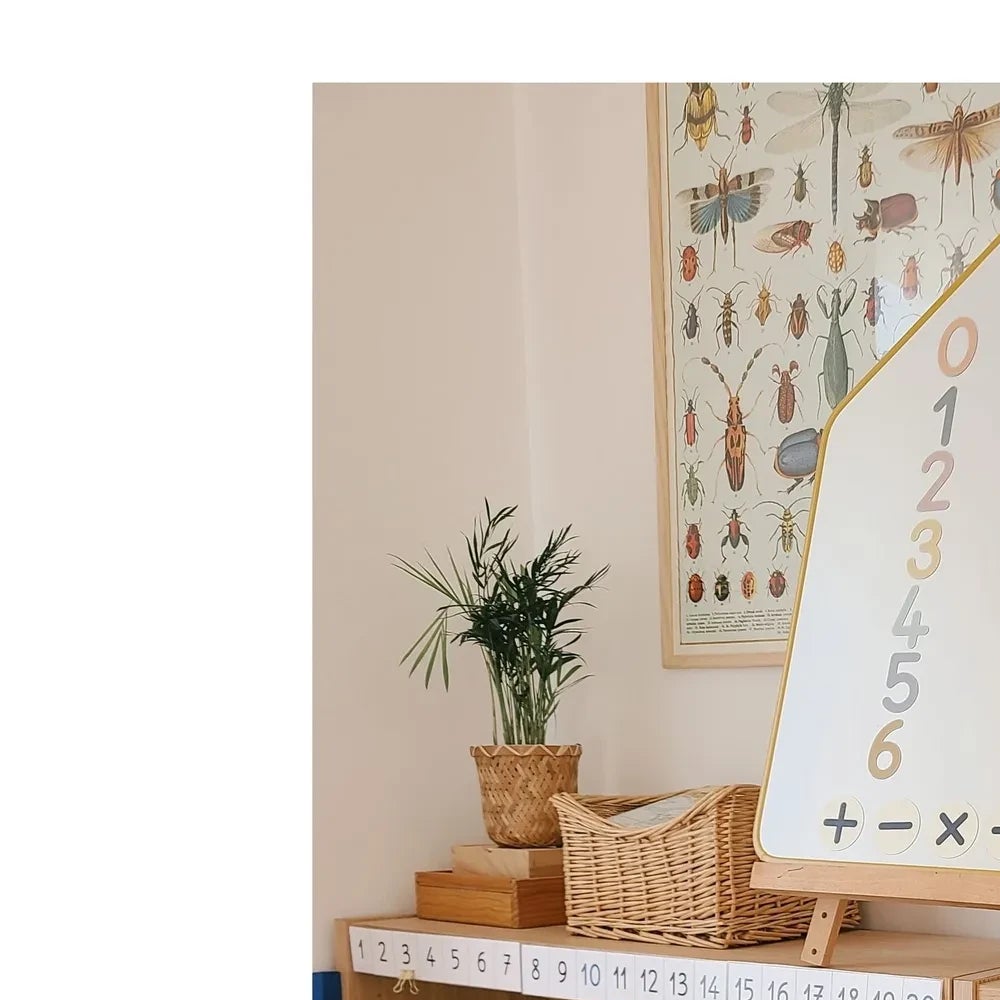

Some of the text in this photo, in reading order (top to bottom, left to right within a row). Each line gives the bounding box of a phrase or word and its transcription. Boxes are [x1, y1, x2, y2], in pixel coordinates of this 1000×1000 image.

[937, 315, 979, 378] 0
[932, 385, 959, 447] 1
[915, 449, 955, 513] 2
[906, 518, 943, 580] 3
[891, 585, 930, 650] 4
[881, 651, 922, 714] 5
[866, 718, 905, 781] 6
[377, 940, 388, 963] 2
[401, 943, 411, 965] 3
[426, 946, 437, 968] 4
[450, 948, 460, 970] 5
[477, 951, 487, 973] 6
[502, 953, 513, 976] 7
[531, 957, 541, 981] 8
[557, 960, 568, 984] 9
[580, 962, 601, 987] 10
[612, 965, 628, 990] 11
[639, 968, 659, 994] 12
[668, 971, 689, 997] 13
[699, 974, 720, 1000] 14
